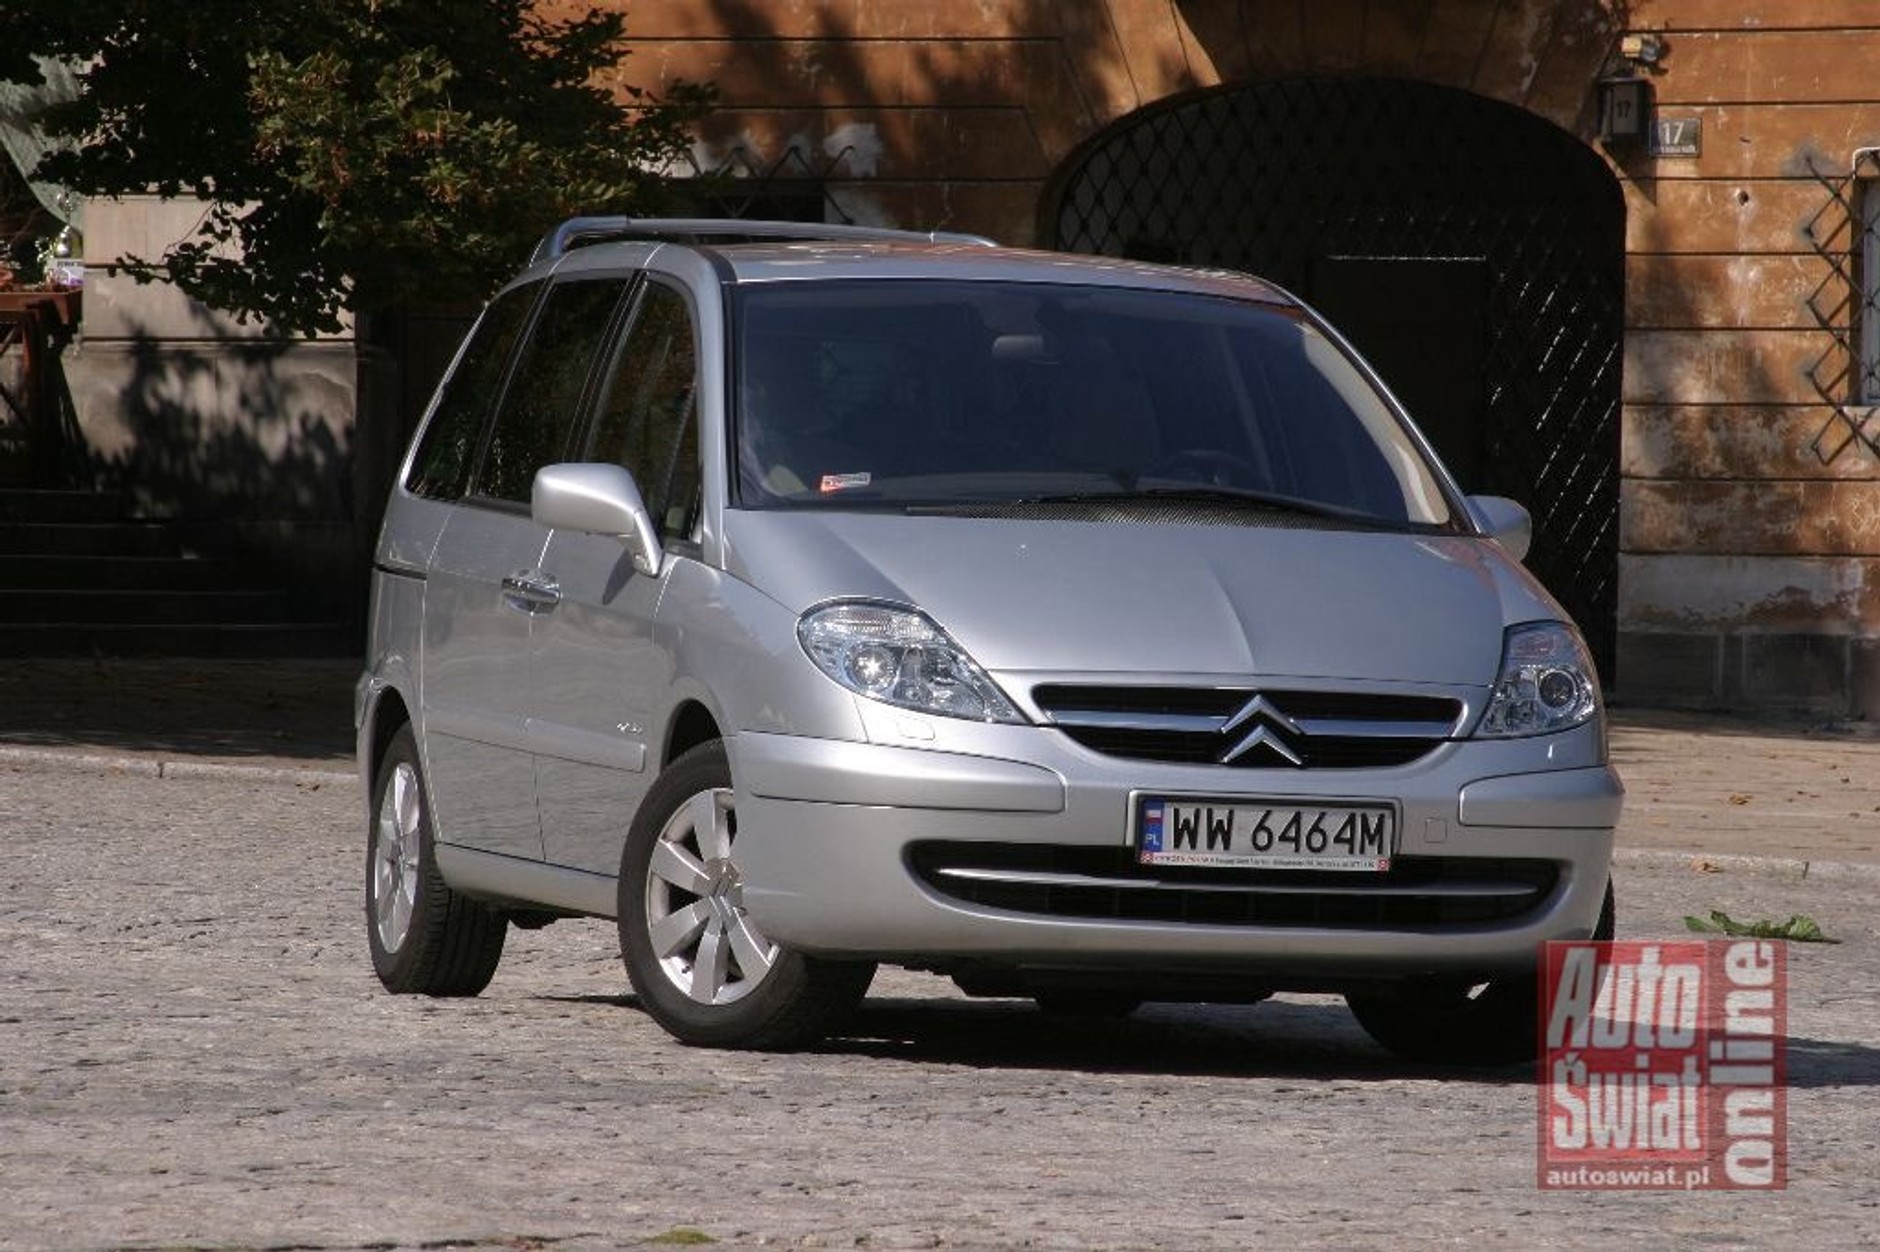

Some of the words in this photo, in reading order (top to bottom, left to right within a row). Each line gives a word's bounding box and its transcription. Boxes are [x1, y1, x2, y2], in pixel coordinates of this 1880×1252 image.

[1616, 101, 1631, 119] 17
[1662, 122, 1685, 144] 17
[1145, 834, 1160, 847] PL
[1173, 807, 1234, 850] WW
[1251, 809, 1385, 855] 6464M
